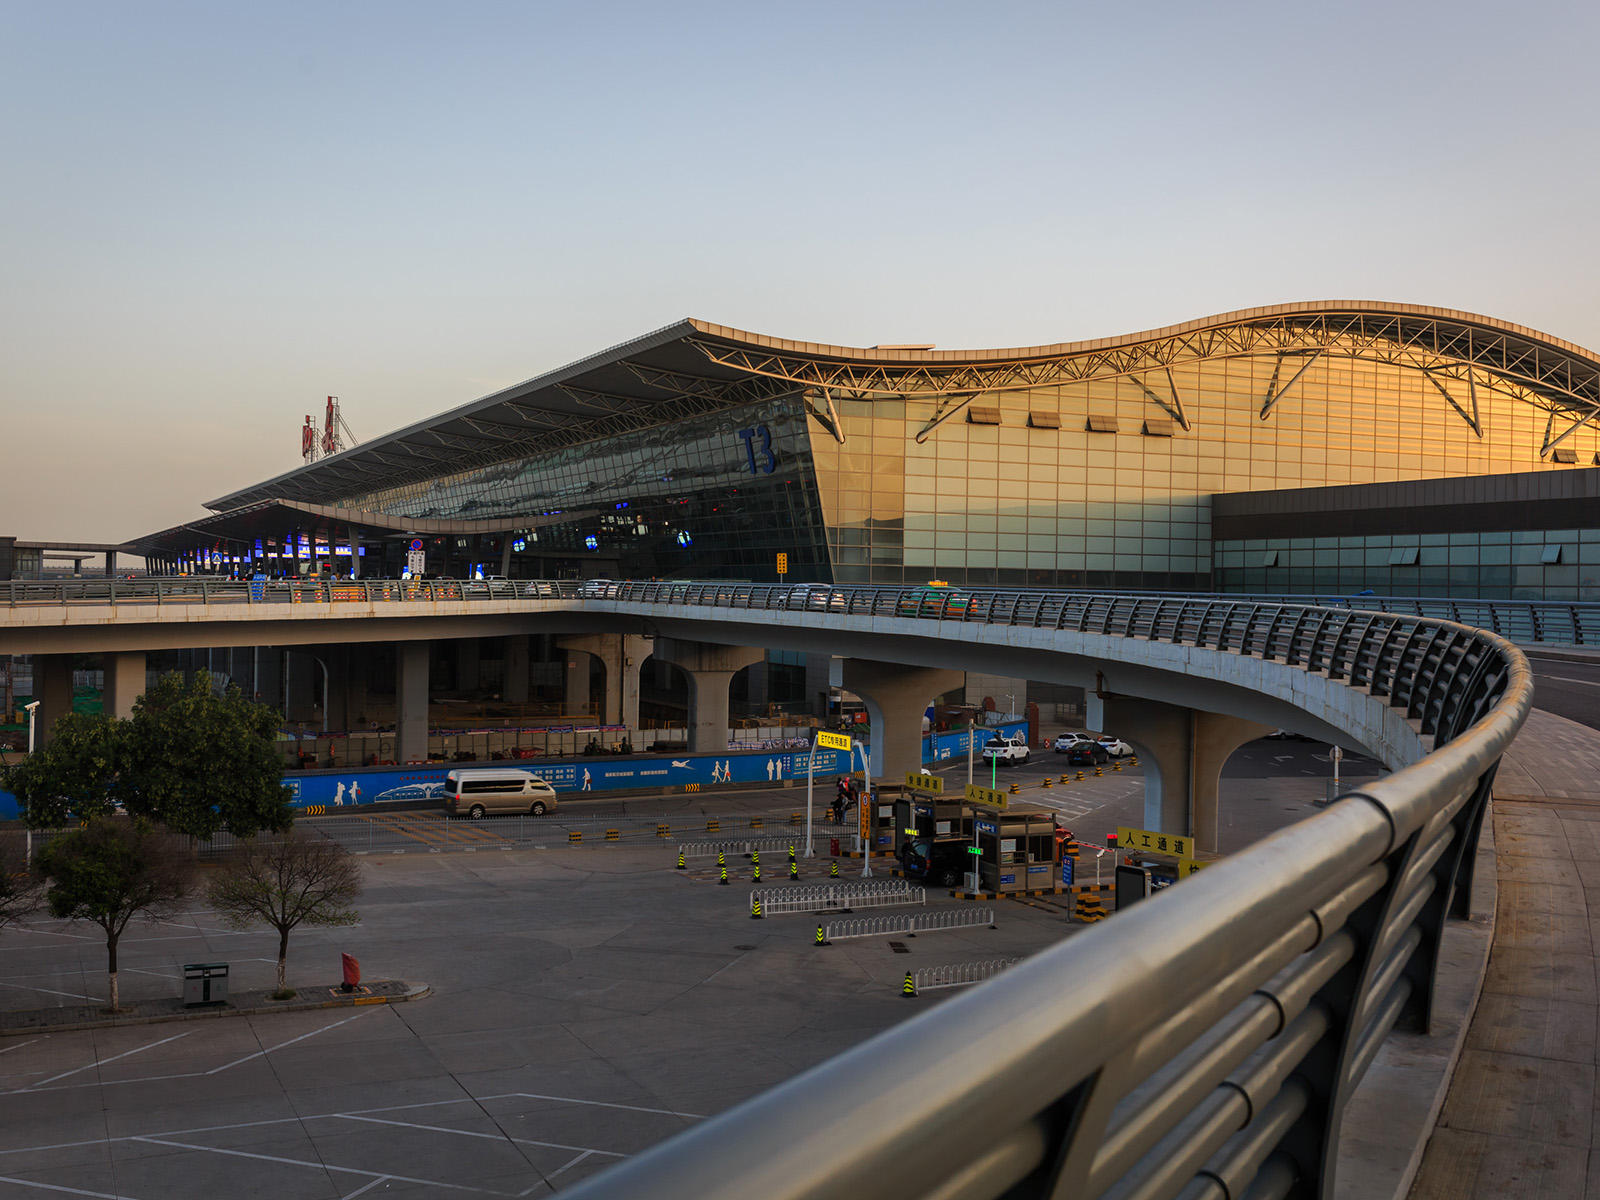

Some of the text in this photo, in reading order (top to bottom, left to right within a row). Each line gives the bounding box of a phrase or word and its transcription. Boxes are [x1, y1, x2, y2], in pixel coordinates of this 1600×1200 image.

[739, 426, 776, 475] T3
[969, 788, 1003, 805] 人工通道
[1125, 831, 1185, 855] 人工通道
